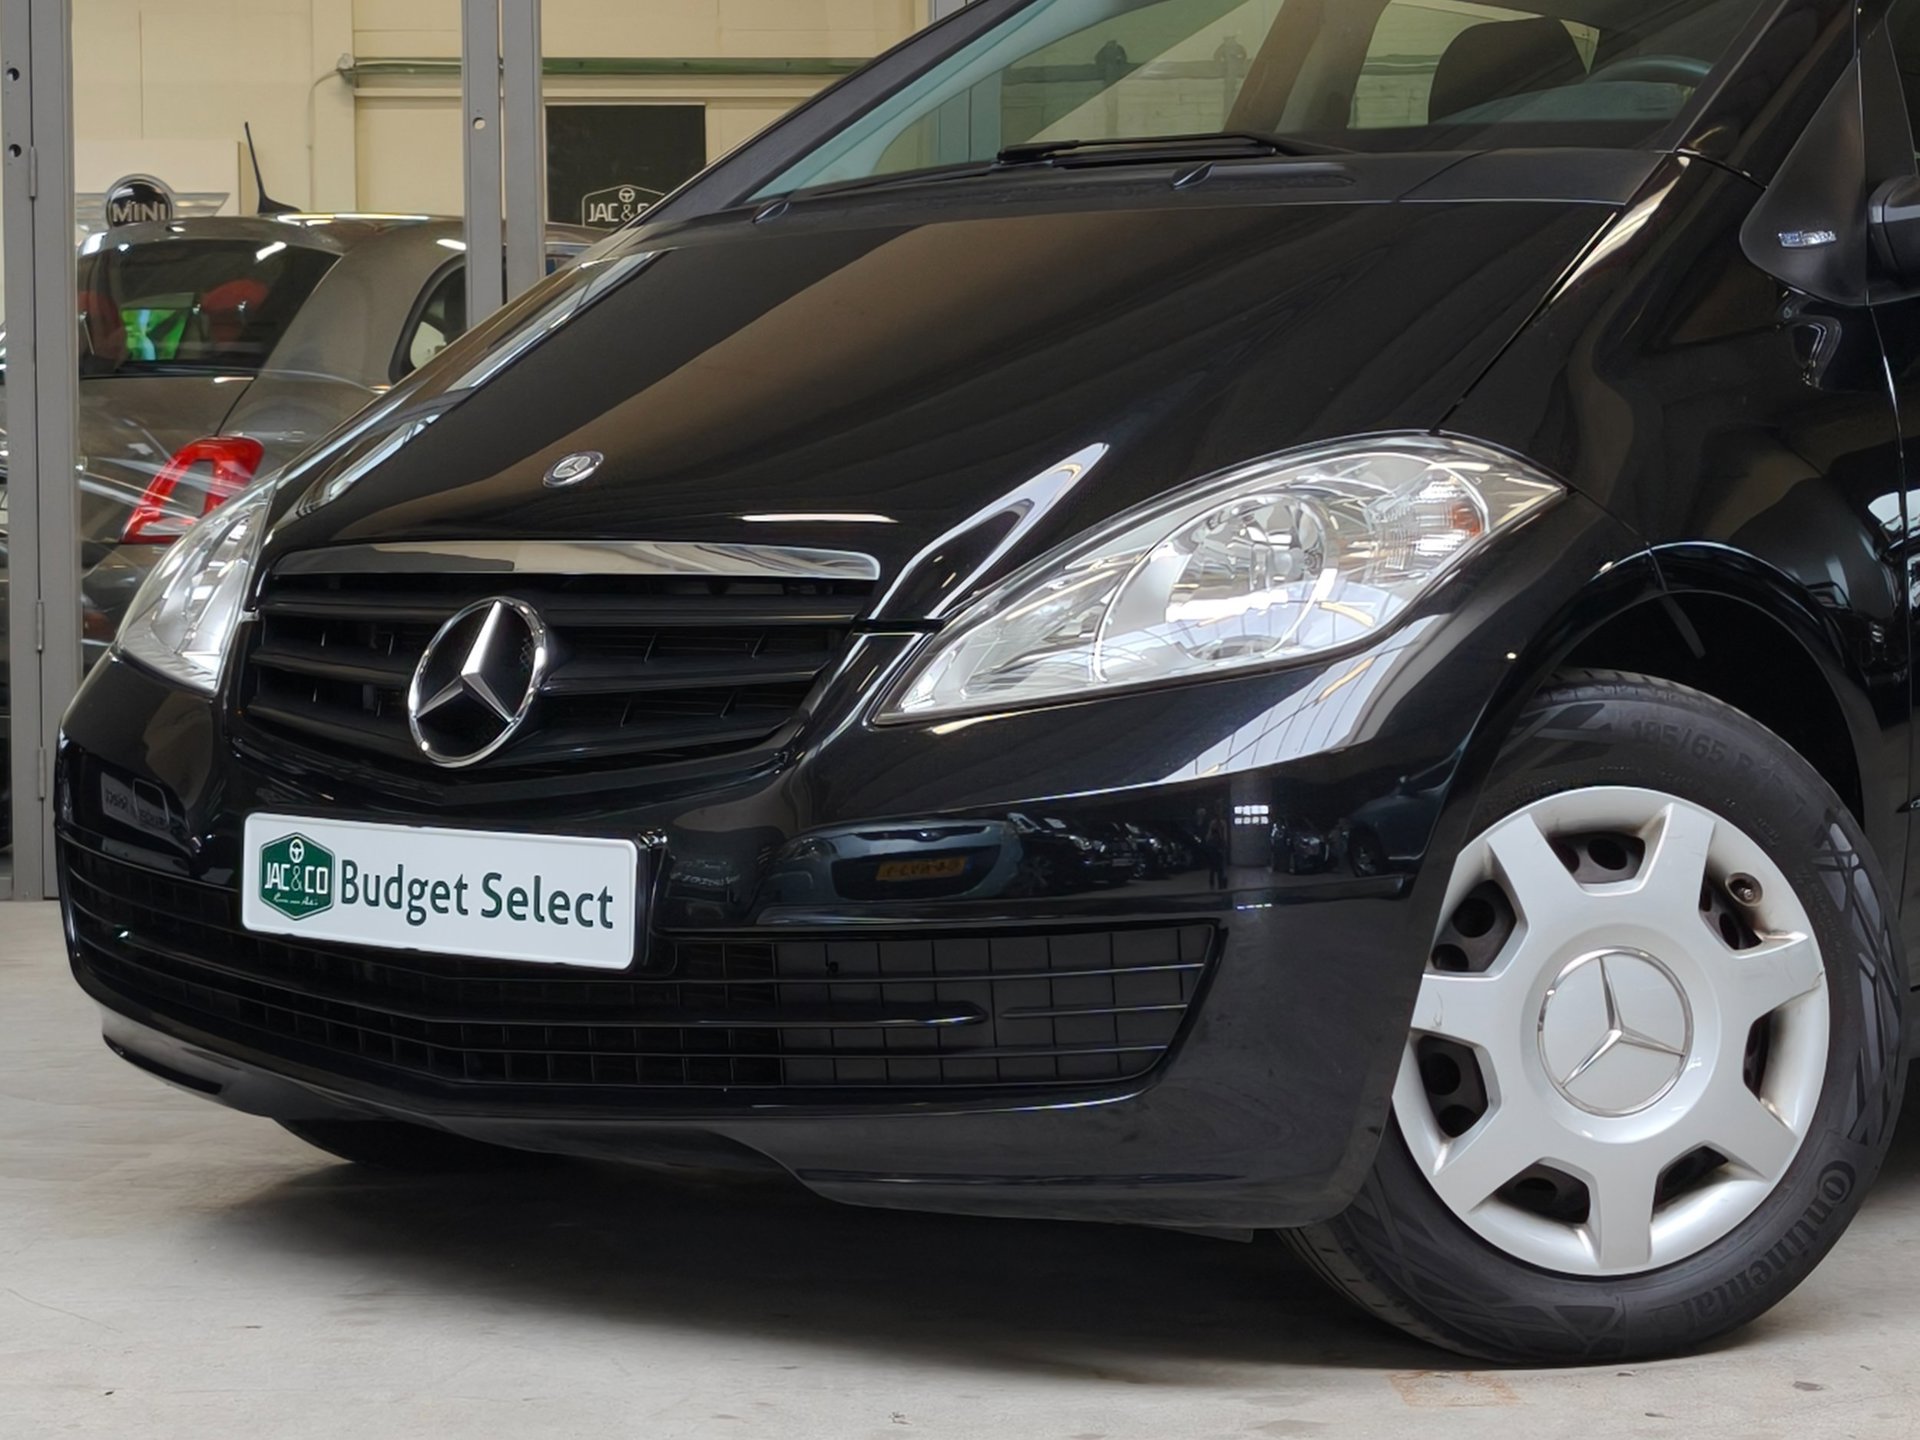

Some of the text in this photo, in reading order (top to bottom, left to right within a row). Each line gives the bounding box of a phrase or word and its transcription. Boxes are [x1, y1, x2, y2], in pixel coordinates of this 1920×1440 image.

[112, 200, 167, 223] MINI
[341, 859, 614, 929] Budget Select
[1684, 1159, 1858, 1326] Continental
